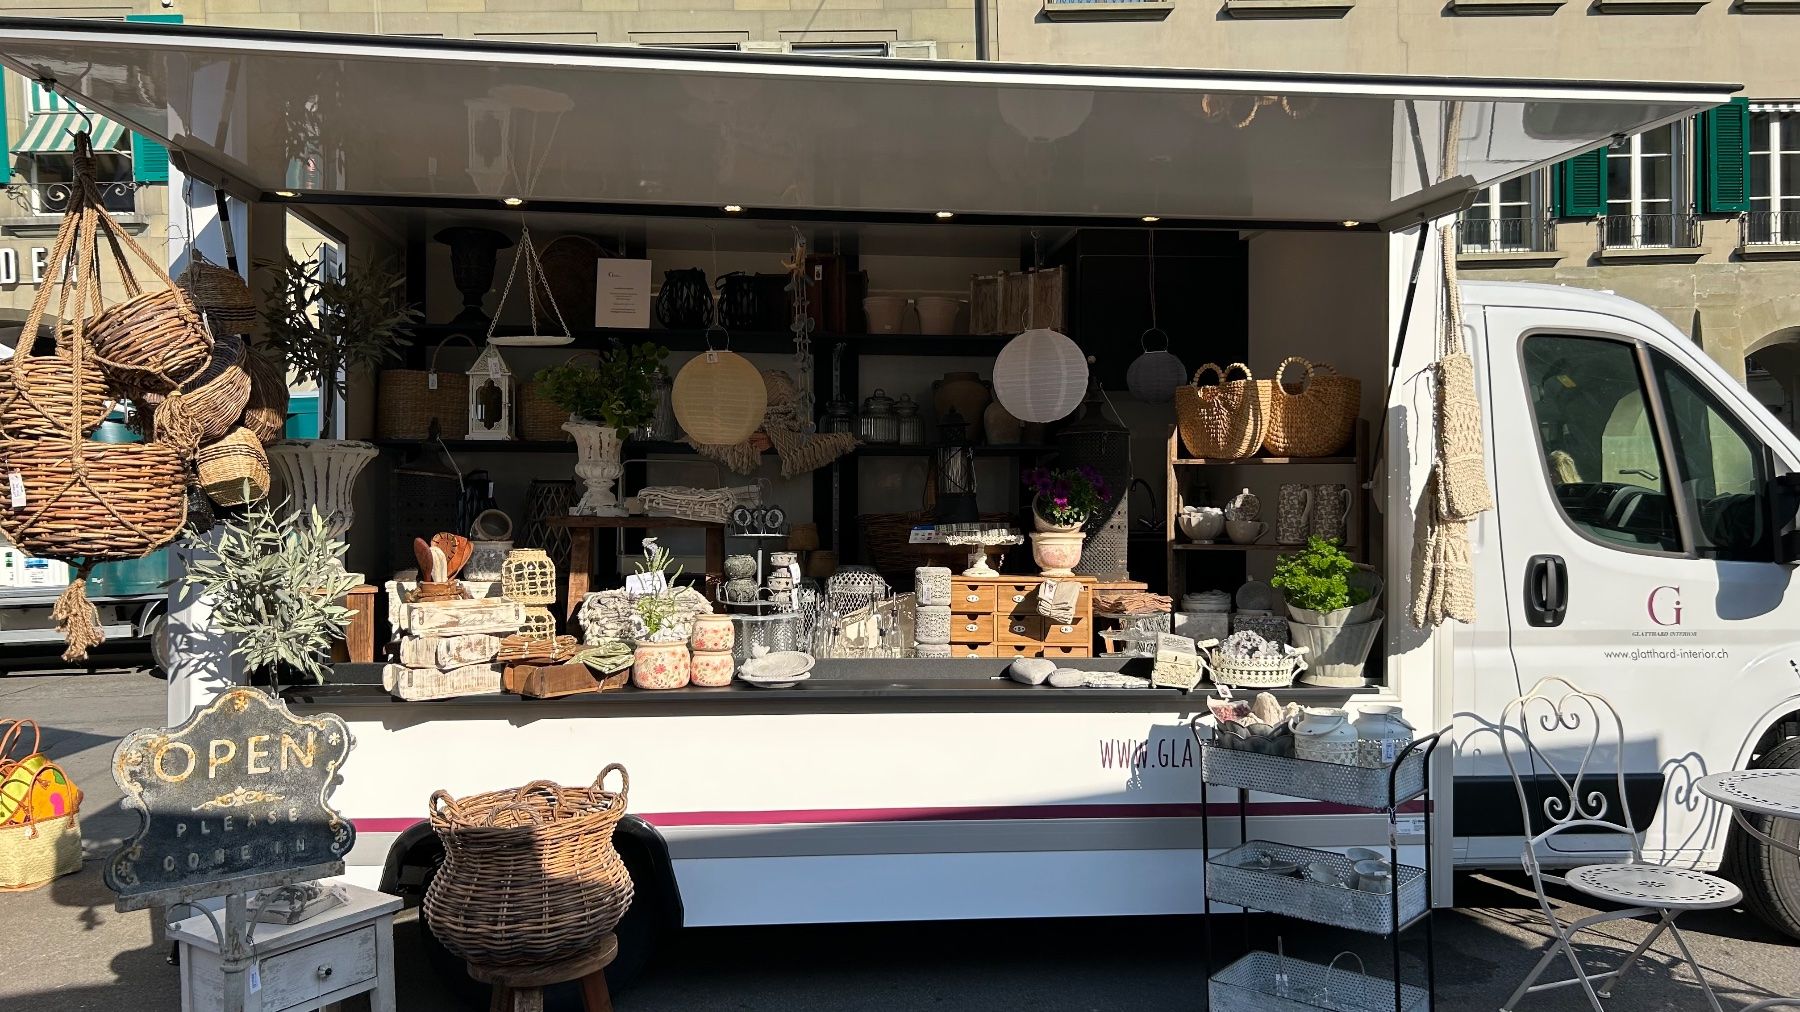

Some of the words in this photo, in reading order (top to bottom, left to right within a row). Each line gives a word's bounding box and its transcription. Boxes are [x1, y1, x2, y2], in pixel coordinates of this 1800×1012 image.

[1604, 648, 1728, 661] www.glatthard-interior.ch
[153, 731, 317, 783] OPEN
[176, 807, 299, 838] PLEASE
[163, 845, 251, 872] COME
[274, 838, 306, 853] IN
